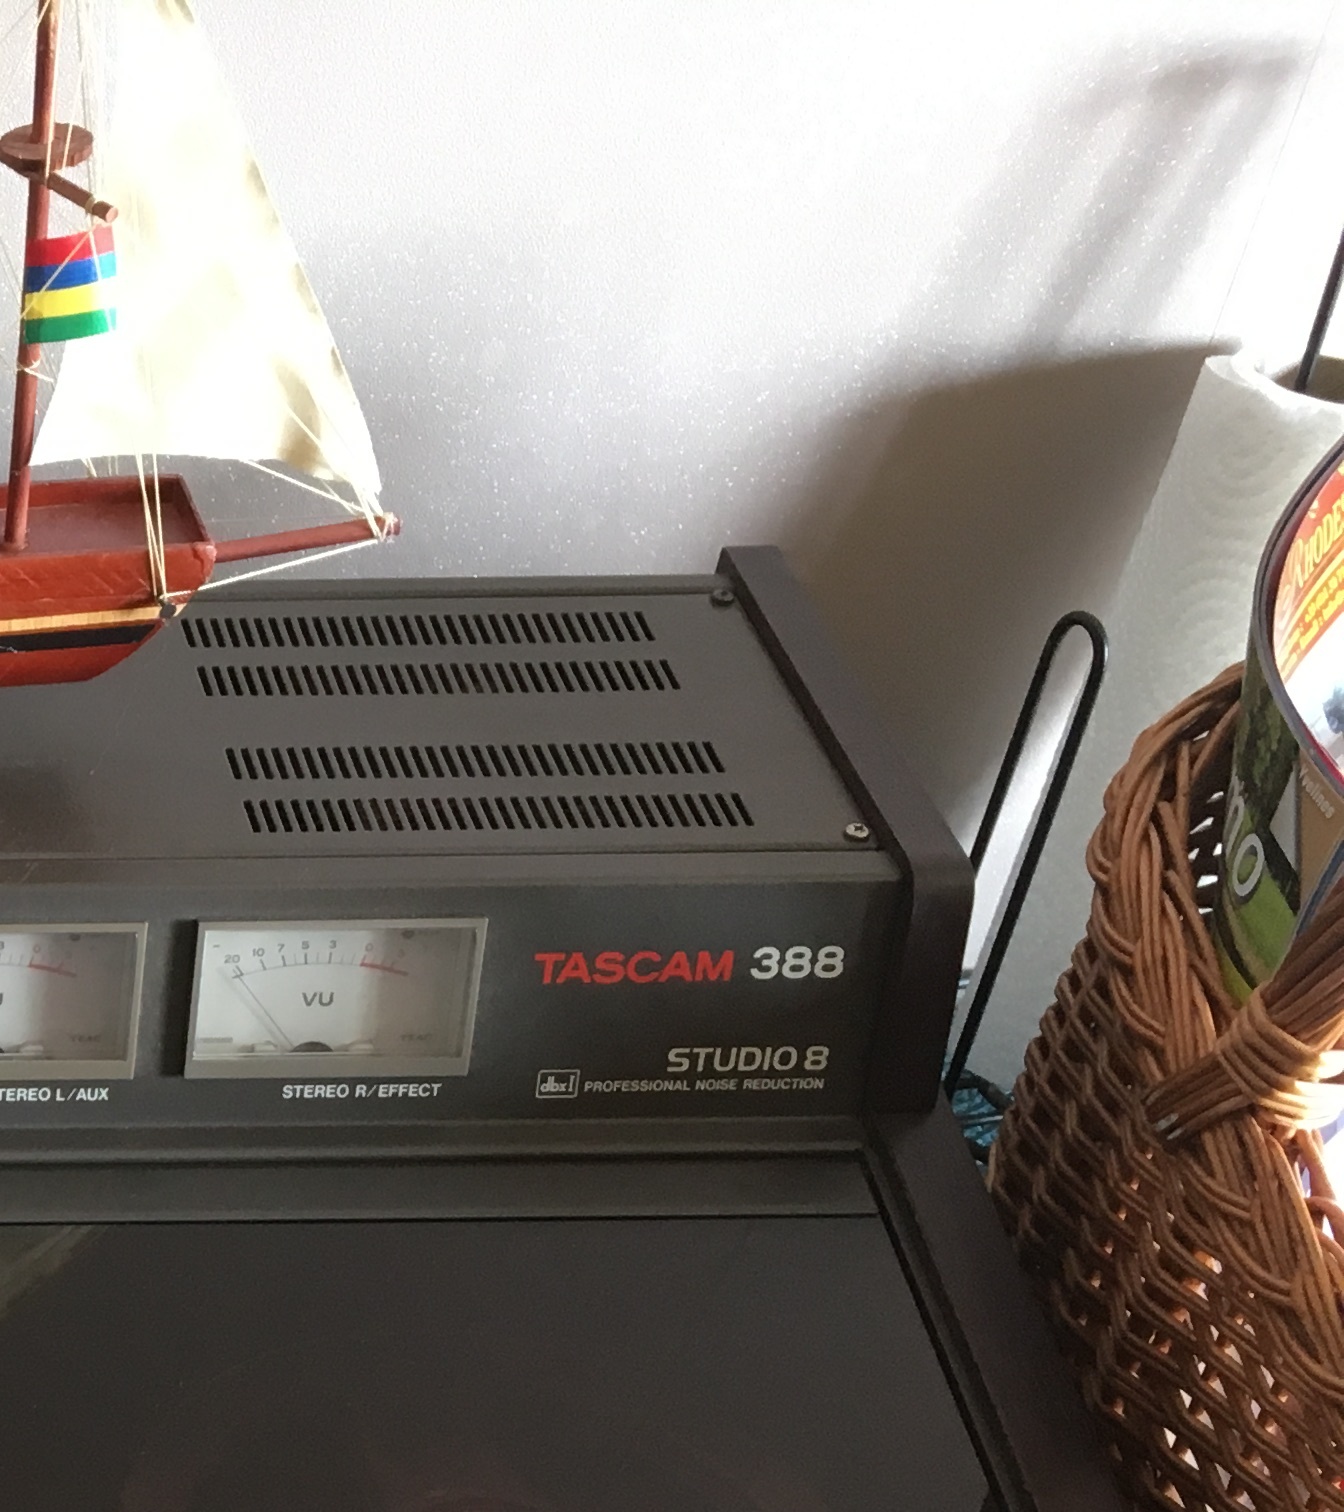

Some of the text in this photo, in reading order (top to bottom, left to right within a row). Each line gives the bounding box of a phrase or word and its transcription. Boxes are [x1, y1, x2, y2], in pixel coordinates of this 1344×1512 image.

[535, 946, 844, 984] TASCAM 388
[303, 992, 334, 1006] VU
[667, 1046, 829, 1072] STUDIO 8
[282, 1084, 442, 1098] STEREO R/EFFECT
[584, 1078, 824, 1092] PROFESSIONAL NOISE REDUCTION
[56, 1088, 108, 1101] L/AUX
